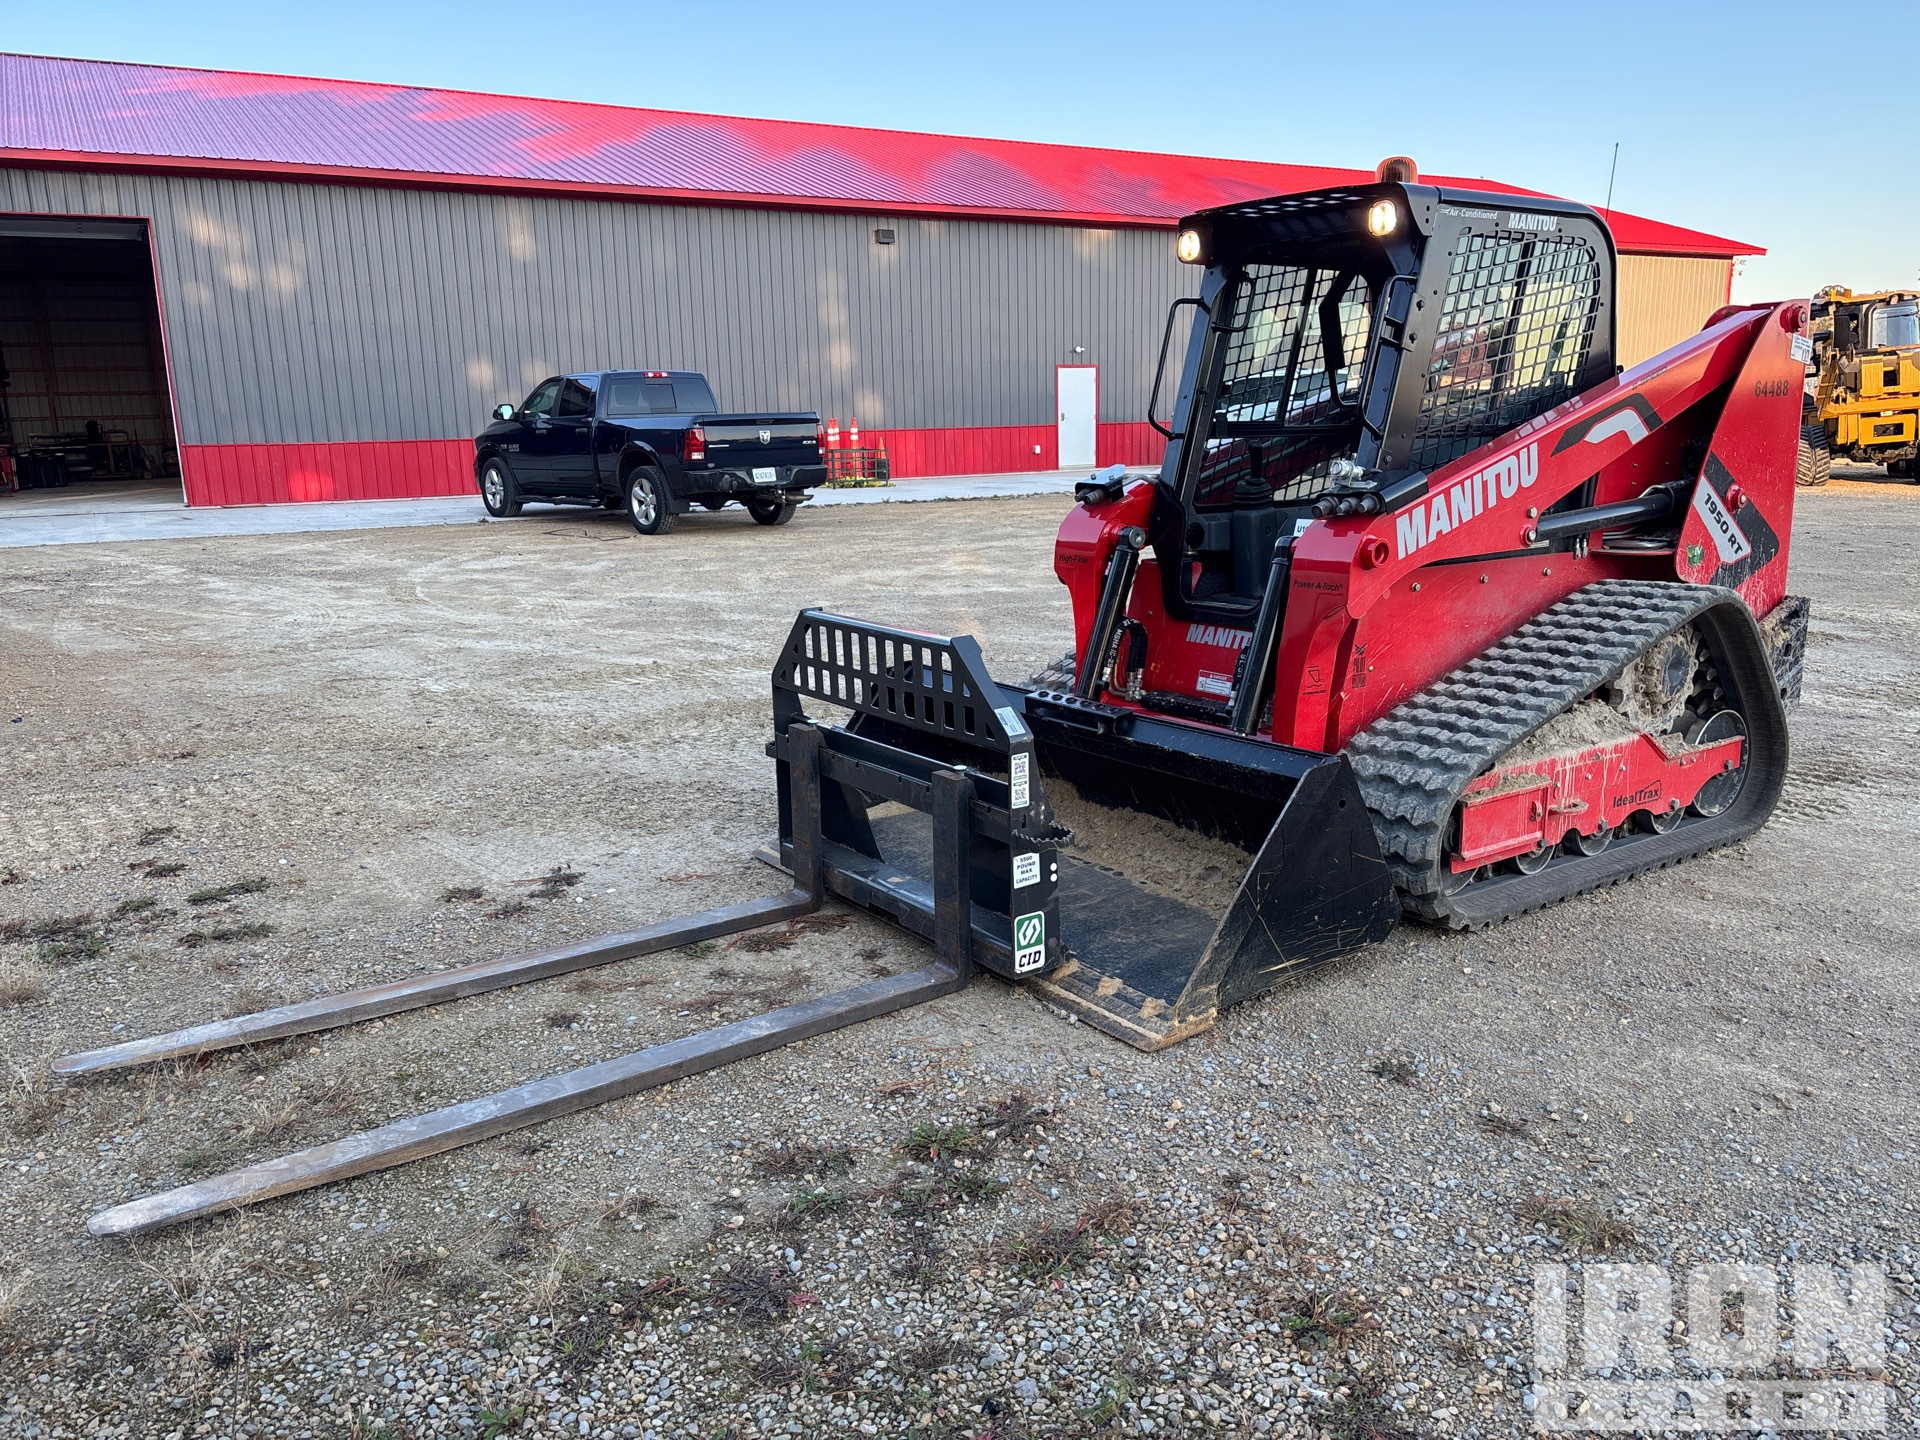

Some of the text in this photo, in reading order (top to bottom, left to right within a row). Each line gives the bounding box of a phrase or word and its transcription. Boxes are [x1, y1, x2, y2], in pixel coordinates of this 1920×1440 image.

[1449, 208, 1498, 220] Air-Conditioned
[1508, 213, 1558, 232] MANITOU
[1755, 380, 1789, 397] 64488
[1395, 442, 1539, 560] MANITOU
[1704, 493, 1744, 555] 1950 RT
[1058, 553, 1089, 564] High-Flow
[1186, 623, 1253, 650] MANITO
[1613, 788, 1660, 809] IdealTrax
[1016, 860, 1036, 870] POUND
[1020, 868, 1033, 876] MAX
[1015, 874, 1037, 885] CAPACITY
[1018, 949, 1042, 968] CID
